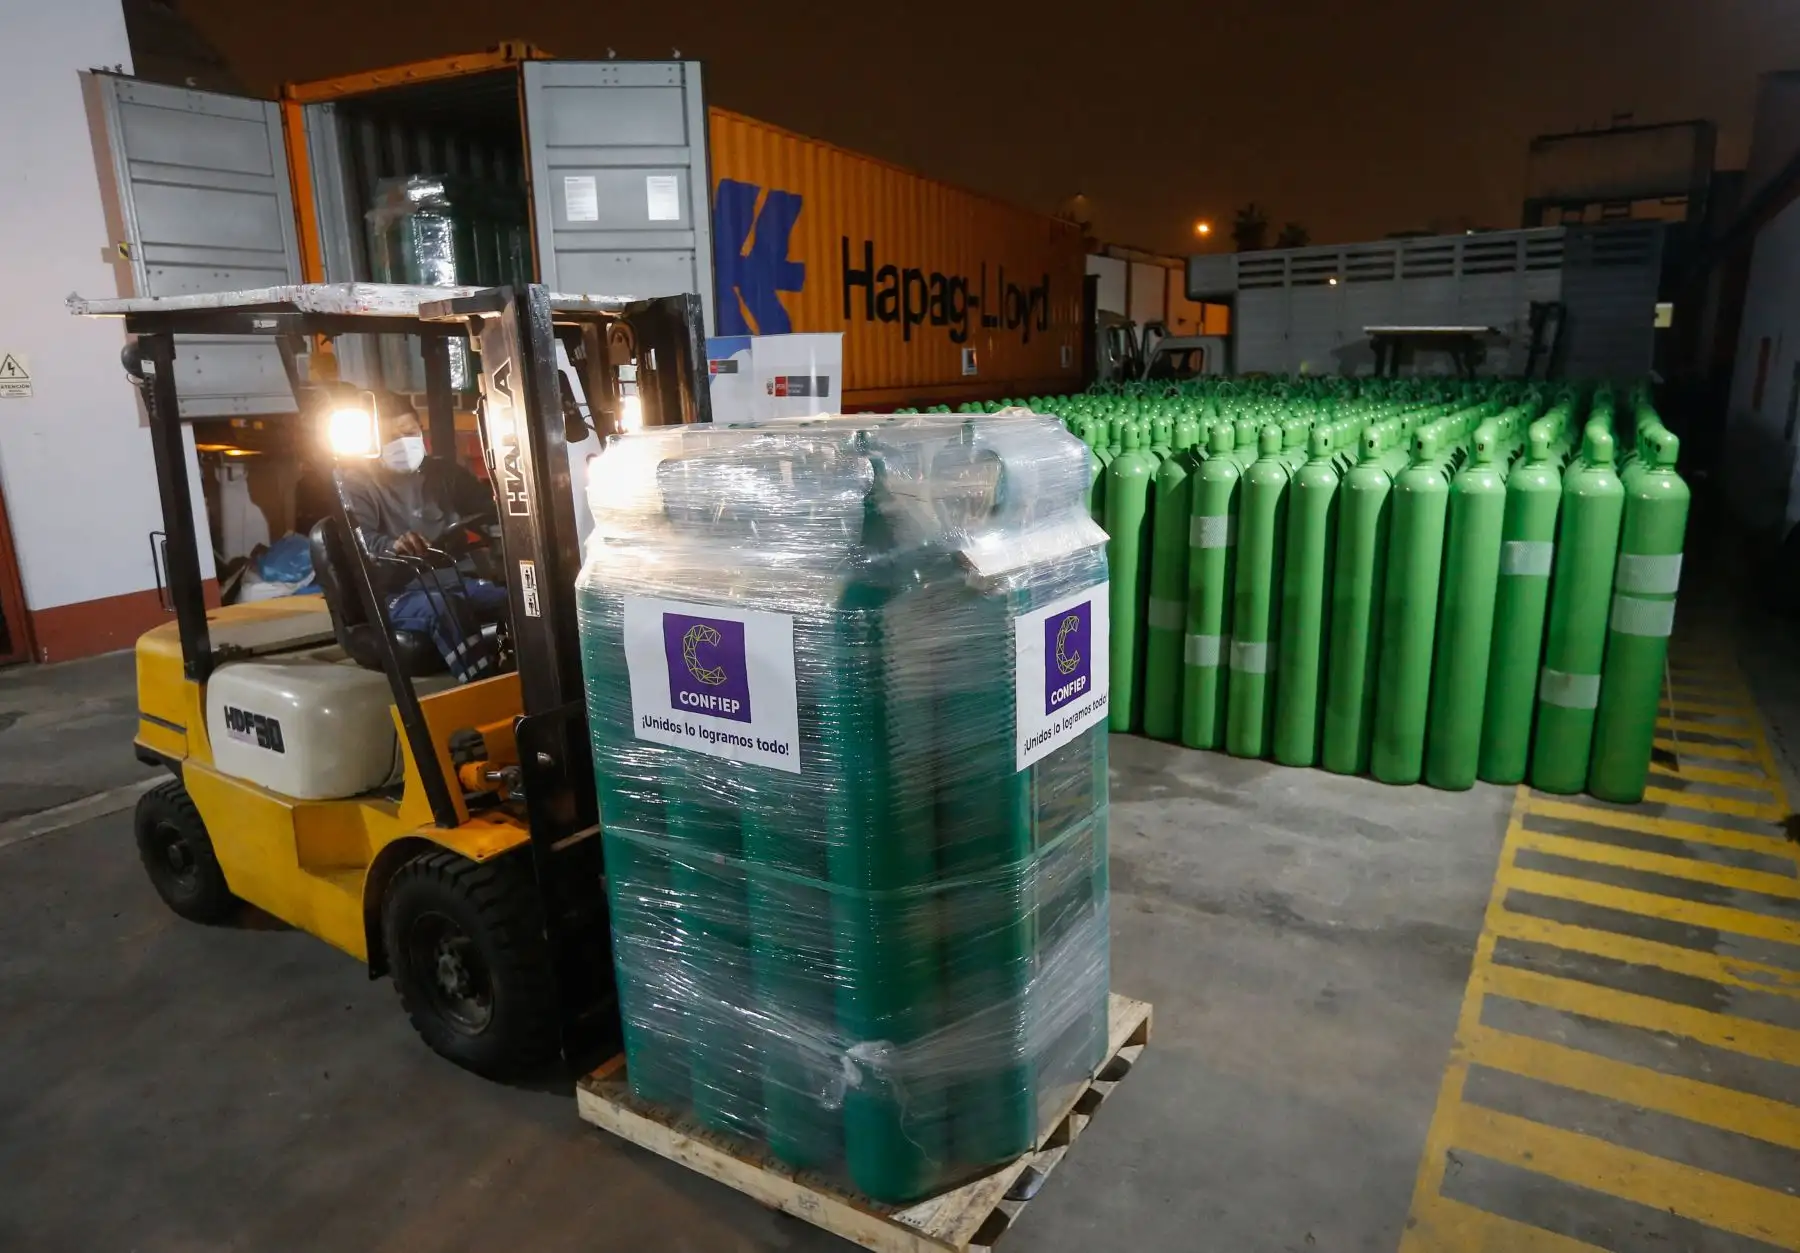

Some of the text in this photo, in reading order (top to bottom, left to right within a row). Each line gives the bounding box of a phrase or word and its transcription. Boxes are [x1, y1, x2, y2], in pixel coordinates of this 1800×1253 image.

[842, 235, 1050, 344] Hapag-Lloyd
[679, 690, 740, 714] CONFIEP
[1050, 675, 1087, 705] CONFIEP
[1053, 722, 1061, 734] lo
[1062, 703, 1092, 729] logramos
[642, 715, 790, 756] ¡Unidos lo logramos todo!
